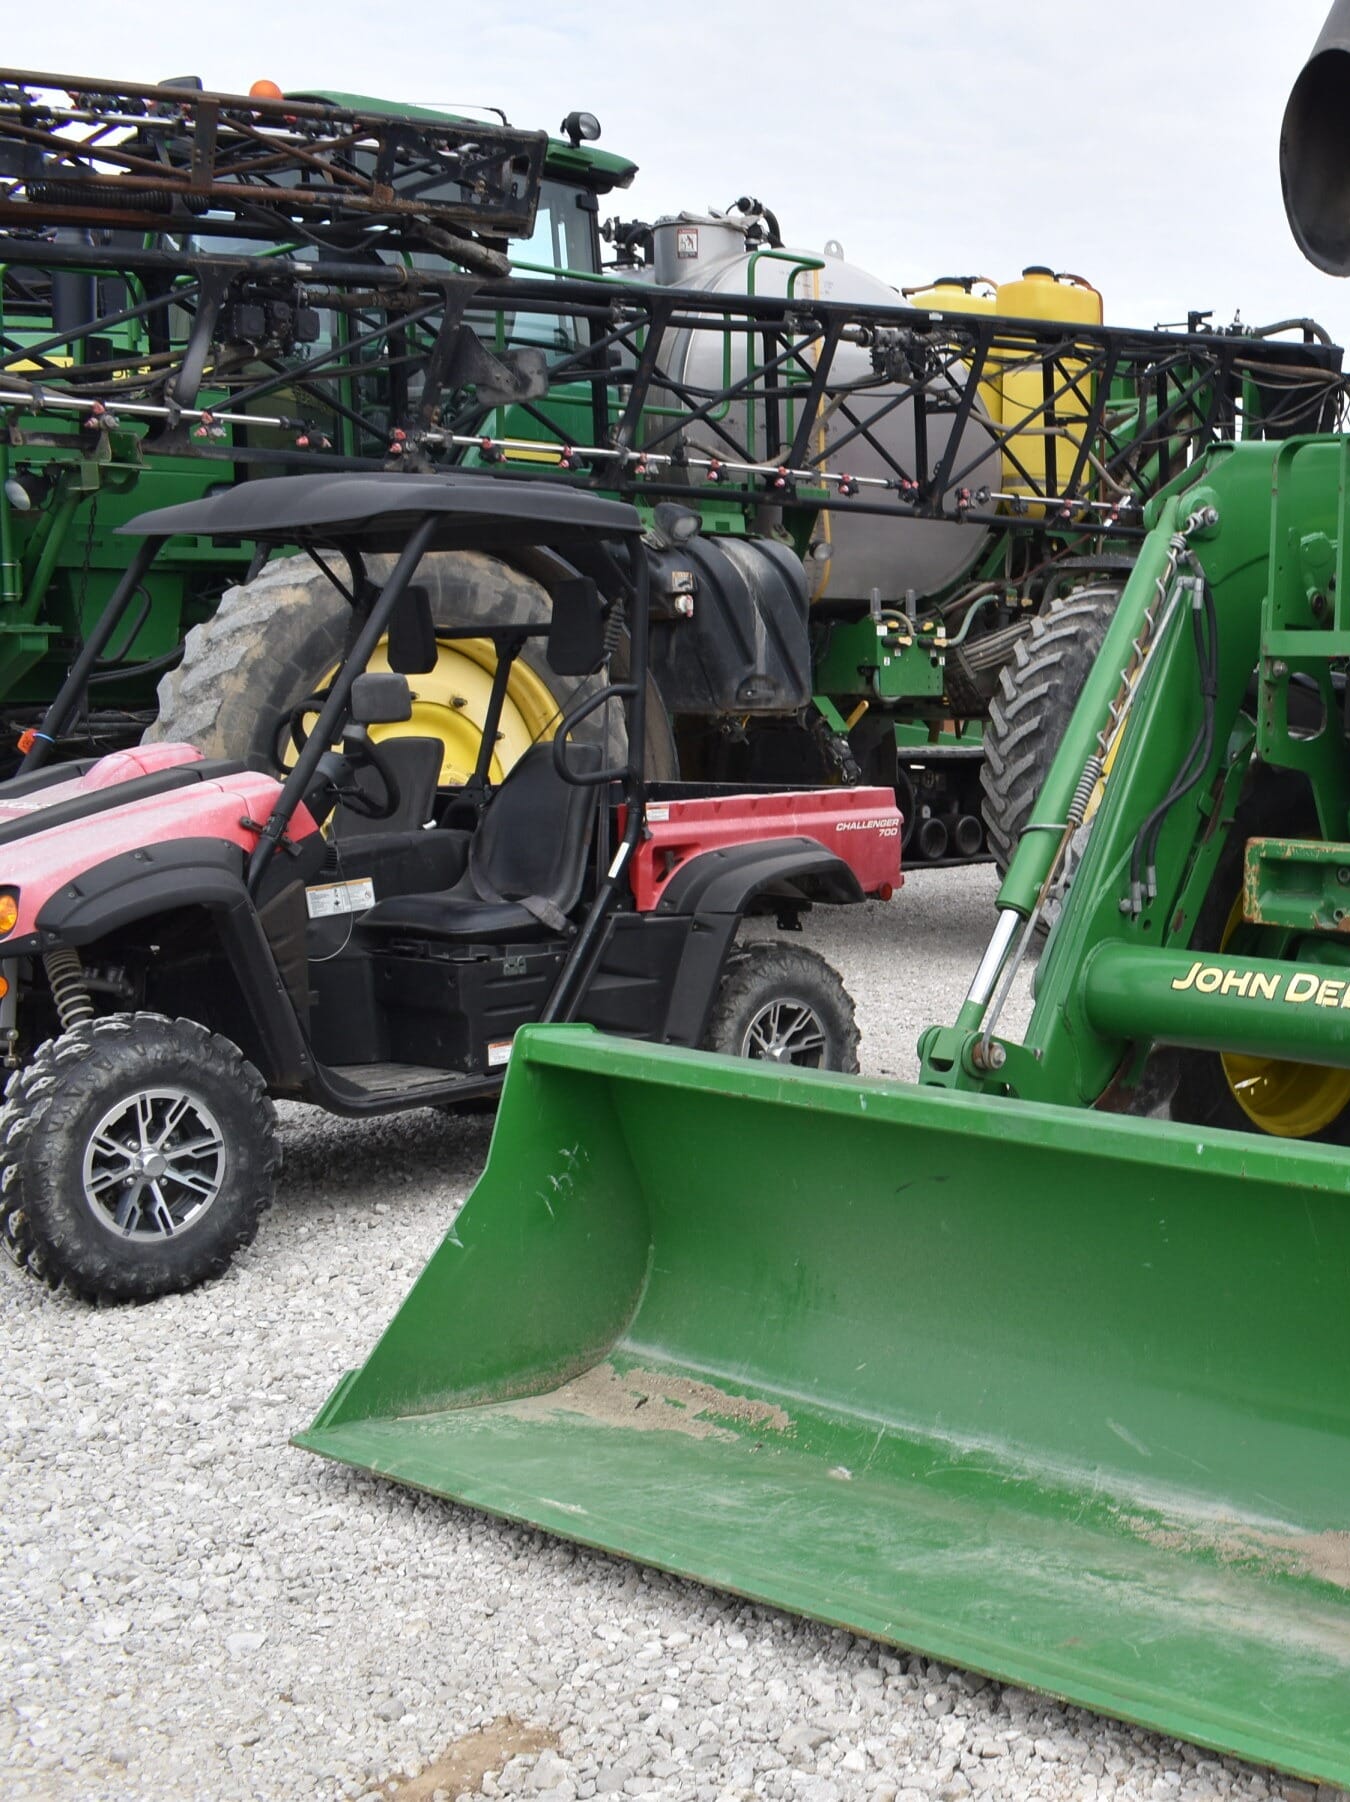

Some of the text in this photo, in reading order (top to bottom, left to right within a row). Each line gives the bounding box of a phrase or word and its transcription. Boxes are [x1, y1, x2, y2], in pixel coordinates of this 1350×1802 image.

[836, 818, 899, 831] CHALLENGER
[879, 828, 898, 837] 700
[1171, 962, 1282, 1000] JOHN
